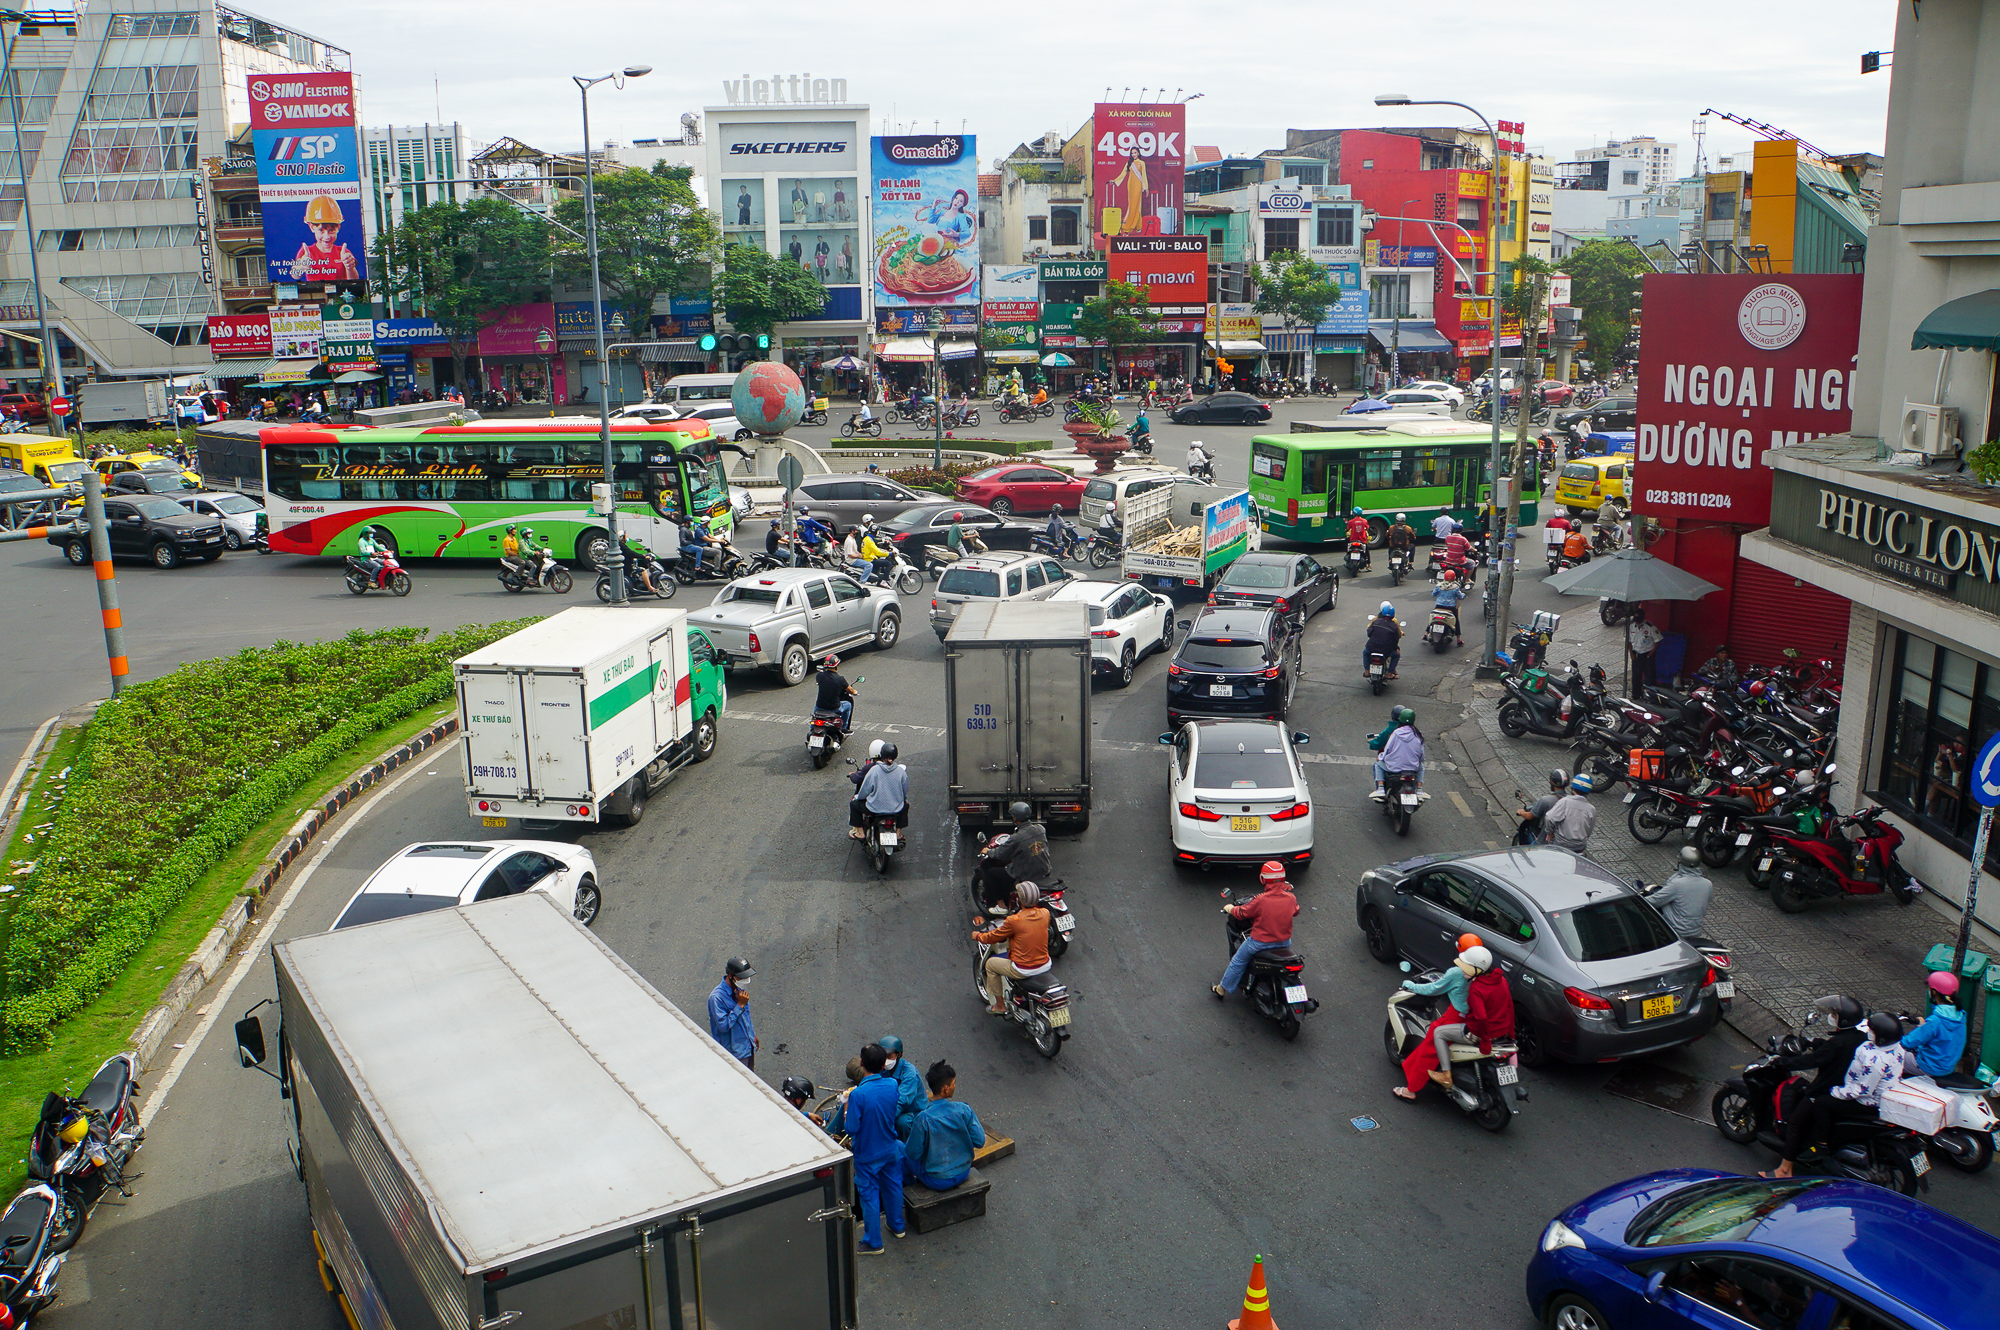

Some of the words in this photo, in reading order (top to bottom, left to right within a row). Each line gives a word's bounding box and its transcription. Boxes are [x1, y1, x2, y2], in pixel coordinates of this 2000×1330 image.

[272, 83, 304, 98] SINO
[306, 86, 349, 97] ELECTRIC
[723, 73, 847, 101] viettien
[283, 103, 350, 119] VANLOCK
[300, 136, 337, 159] SP
[729, 141, 847, 154] SKECHERS
[892, 144, 948, 158] Omachi
[1097, 131, 1181, 157] 499K
[276, 164, 304, 176] SINO
[306, 162, 345, 176] Plastic
[880, 177, 892, 188] MÌ
[894, 179, 921, 190] LẠNH
[332, 187, 347, 195] TOÀN
[902, 190, 921, 201] TÁO
[1274, 197, 1299, 207] ECO
[1532, 193, 1550, 204] SONY
[1117, 242, 1140, 251] VALI
[1149, 240, 1166, 250] TÚI
[1174, 241, 1202, 250] BALO
[1381, 247, 1411, 265] Tiger
[1044, 265, 1063, 277] BÁN
[1065, 264, 1082, 277] TRẢ
[1084, 264, 1104, 277] GÓP
[1147, 270, 1195, 284] mia.vn
[1745, 288, 1777, 309] DUONG
[1779, 289, 1800, 309] MINH
[986, 302, 999, 310] VÉ
[999, 302, 1017, 310] MÁY
[272, 319, 294, 333] BẢO
[295, 320, 322, 334] NGỌC
[688, 320, 698, 328] LAN
[698, 318, 710, 327] CÚC
[912, 315, 926, 324] 341
[209, 321, 233, 339] BẢO
[236, 324, 269, 340] NGỌC
[375, 322, 473, 339] Sacomb
[1743, 322, 1775, 345] LANGUAGE
[1776, 322, 1800, 345] SCHOOL
[328, 345, 353, 357] RAU
[356, 342, 375, 356] MÁ
[1137, 359, 1155, 368] 699
[1664, 364, 1774, 418] NGOẠI
[1638, 420, 1753, 469] DƯƠNG
[419, 464, 484, 477] Linh
[1645, 489, 1669, 504] 028
[1670, 491, 1698, 506] 3811
[1699, 493, 1732, 509] 0204
[1816, 489, 1910, 554] PHUC
[1916, 516, 2000, 584] LON
[1874, 553, 1911, 575] COFFEE
[1913, 566, 1921, 577] &
[1925, 569, 1945, 587] TEA
[602, 670, 611, 684] XE
[611, 662, 623, 680] THƯ
[974, 704, 992, 716] 51D
[472, 715, 482, 723] XE
[483, 714, 497, 723] THƯ
[967, 718, 997, 730] 639.13
[473, 765, 517, 779] 29H-708.13
[1522, 974, 1535, 985] Grab
[1651, 998, 1665, 1008] 51H
[1646, 1005, 1671, 1018] 508.52
